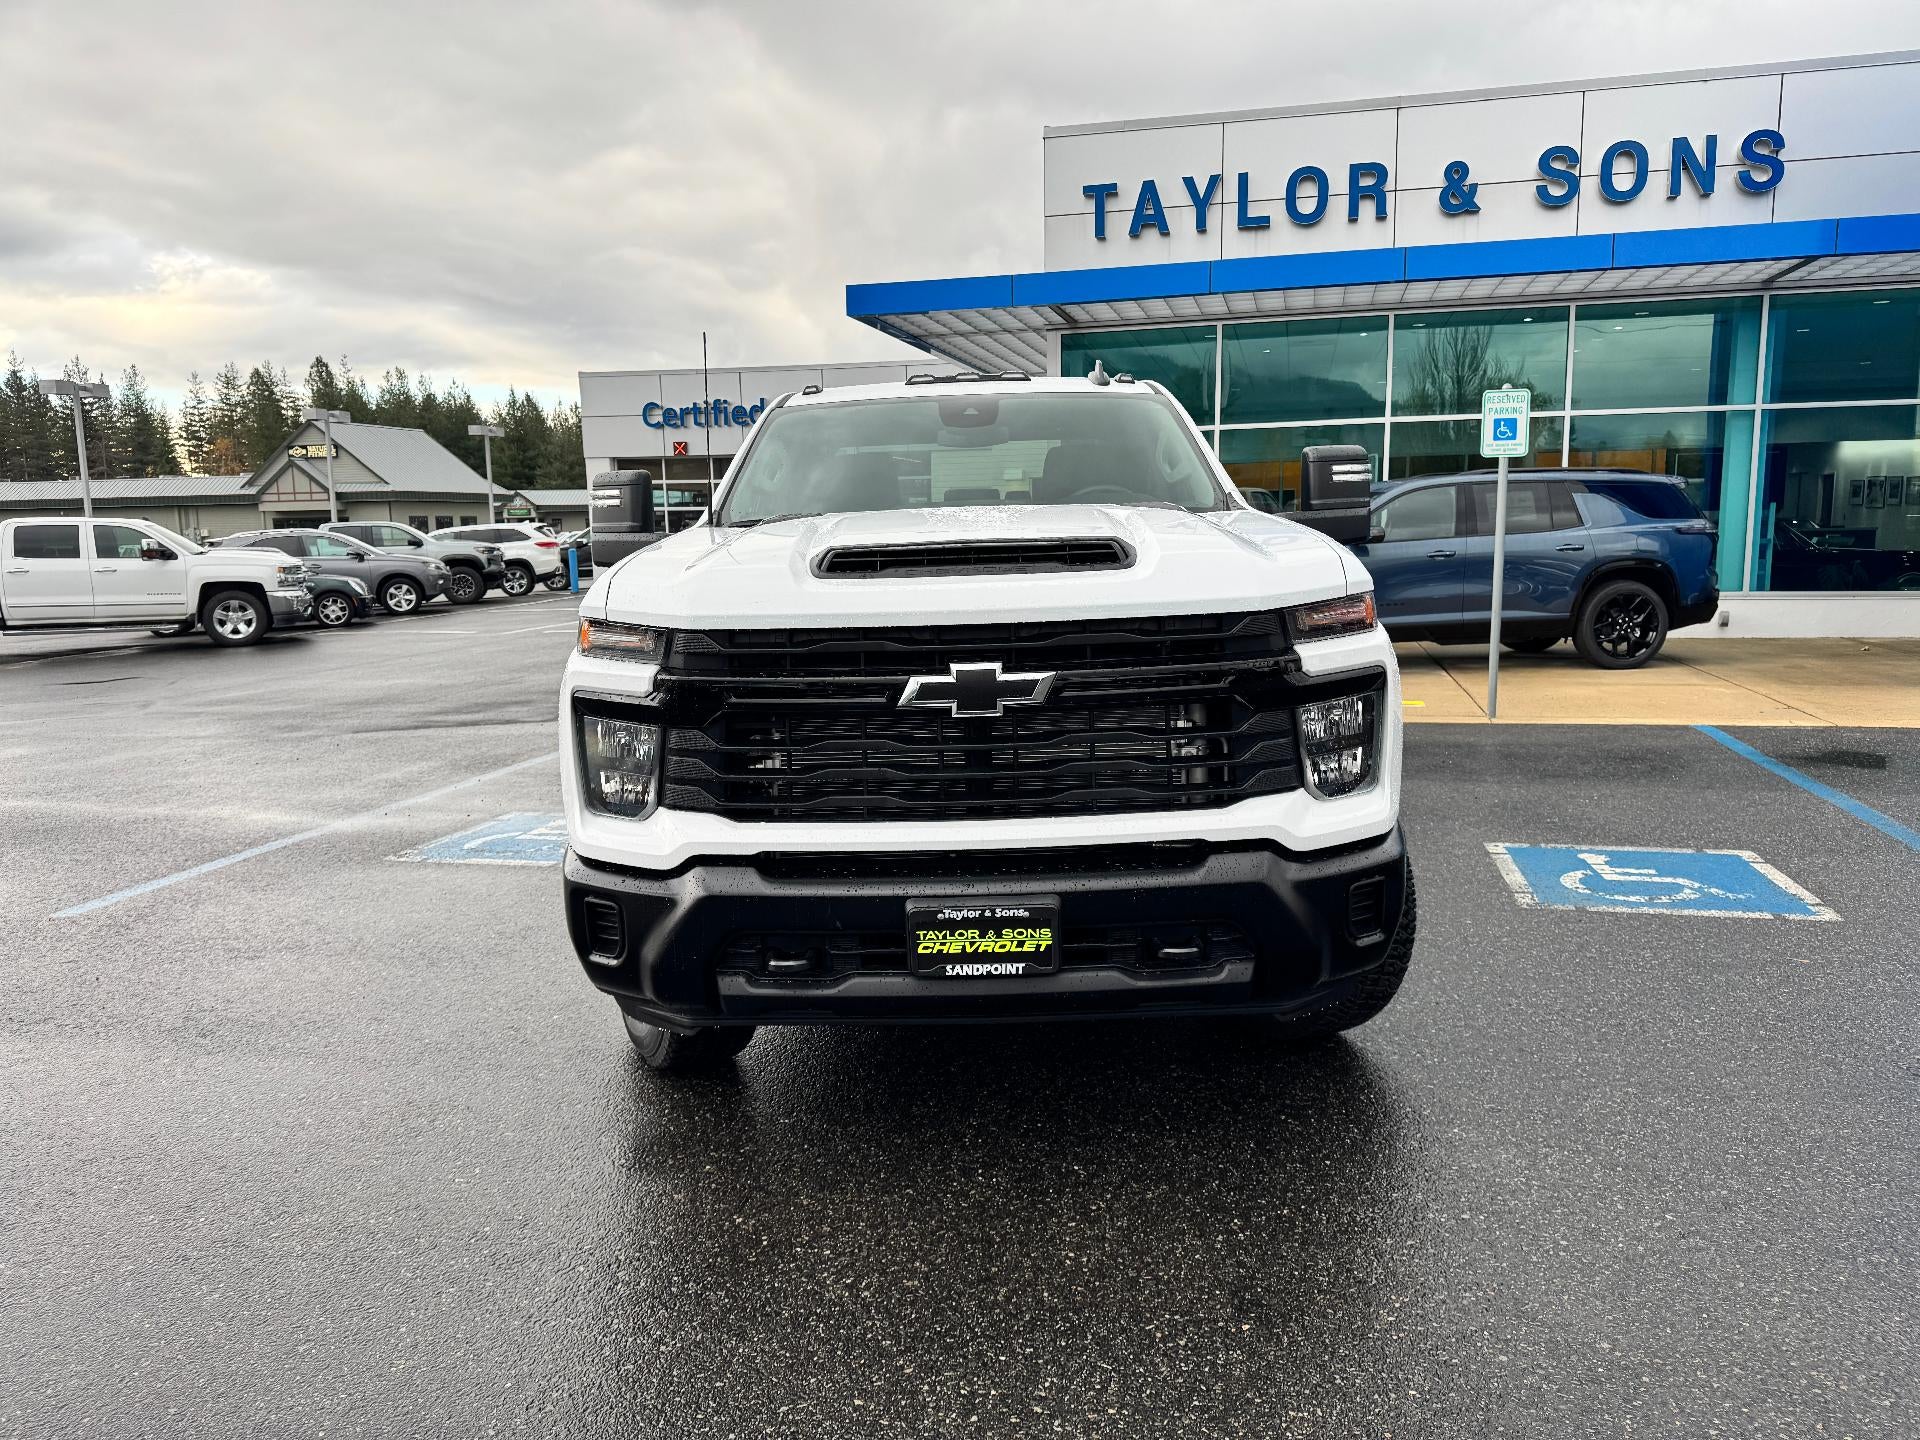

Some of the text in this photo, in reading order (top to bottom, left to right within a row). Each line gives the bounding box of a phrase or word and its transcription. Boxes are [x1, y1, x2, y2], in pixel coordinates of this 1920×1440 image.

[1082, 128, 1786, 240] TAYLOR & SONS
[1486, 394, 1526, 404] RESERVED
[642, 398, 767, 428] Certified
[1488, 406, 1523, 415] PARKING
[943, 908, 1025, 920] Taylor & Sons
[916, 928, 1052, 942] TAYLOR & SONS
[917, 940, 1053, 954] CHEVROLET
[945, 963, 1026, 976] SANDPOINT
